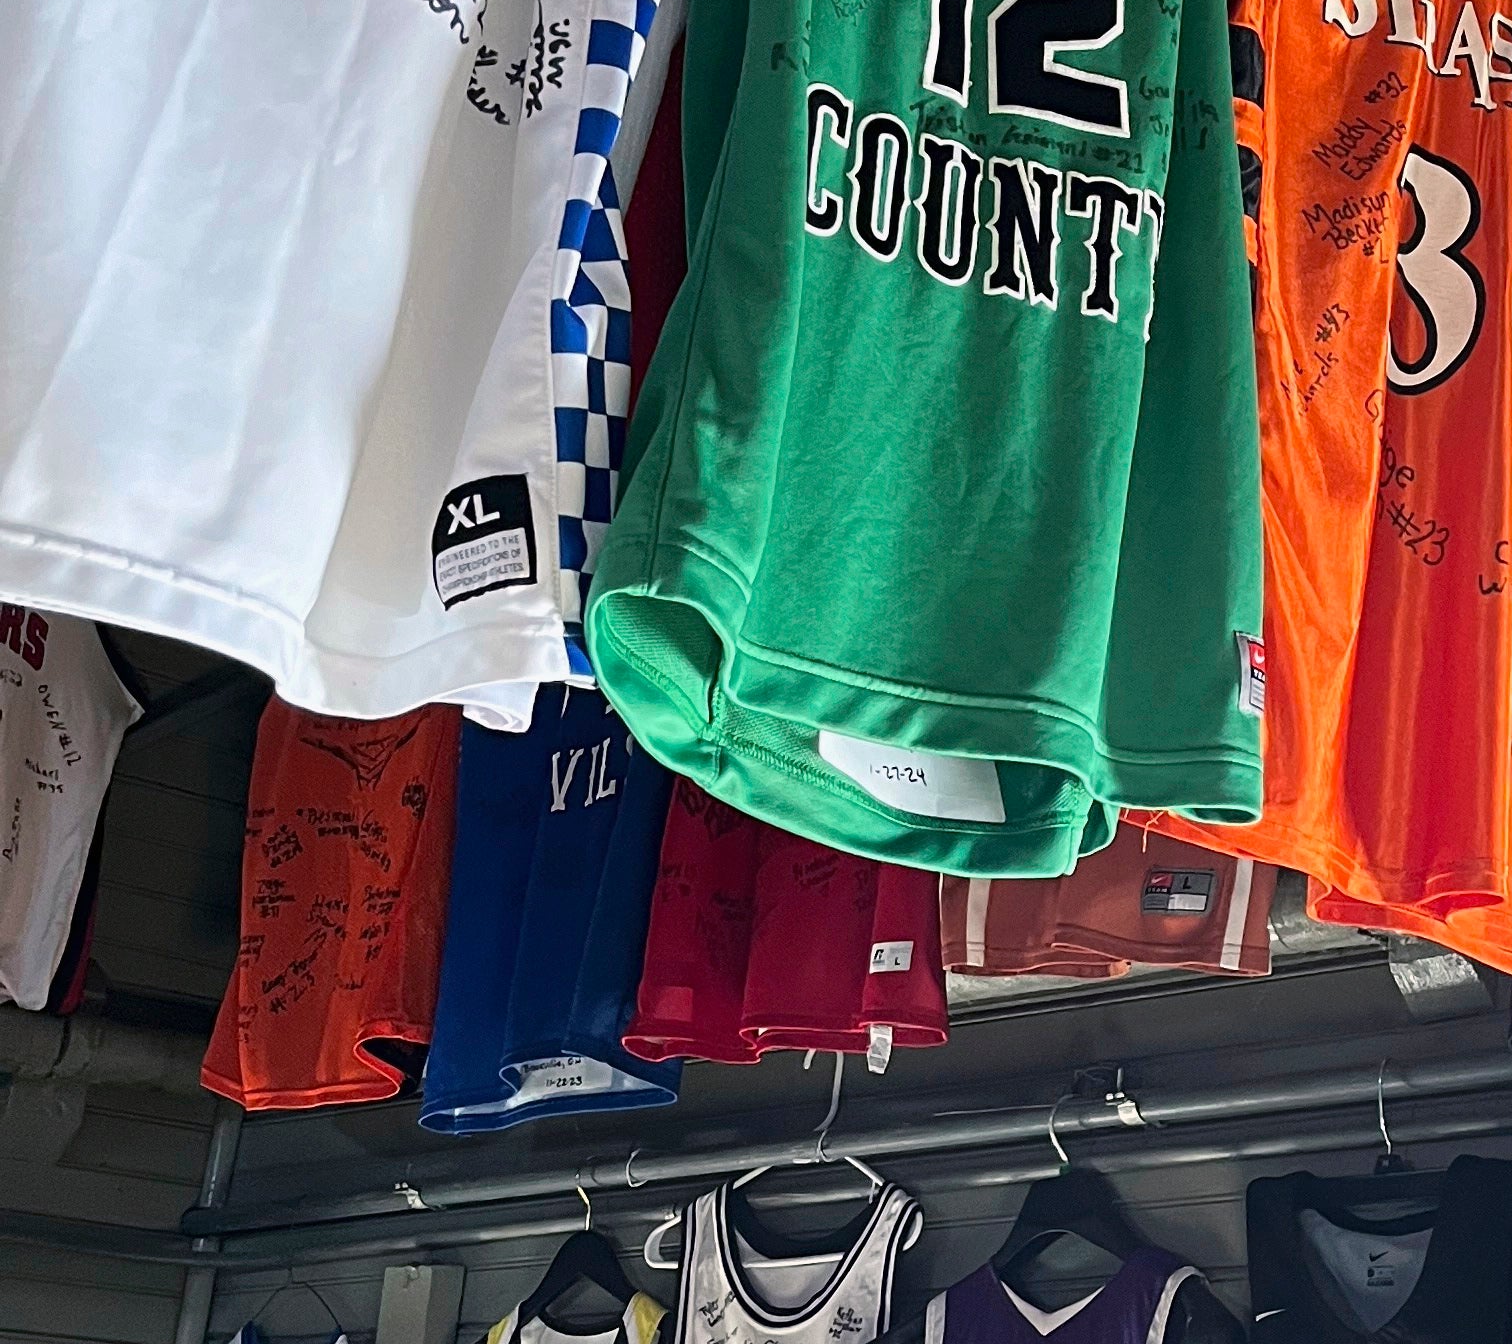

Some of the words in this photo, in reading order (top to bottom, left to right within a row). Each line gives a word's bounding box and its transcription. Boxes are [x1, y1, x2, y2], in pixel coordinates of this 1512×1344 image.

[1312, 118, 1378, 169] Maddy
[447, 494, 500, 535] XL
[1388, 501, 1450, 565] #23
